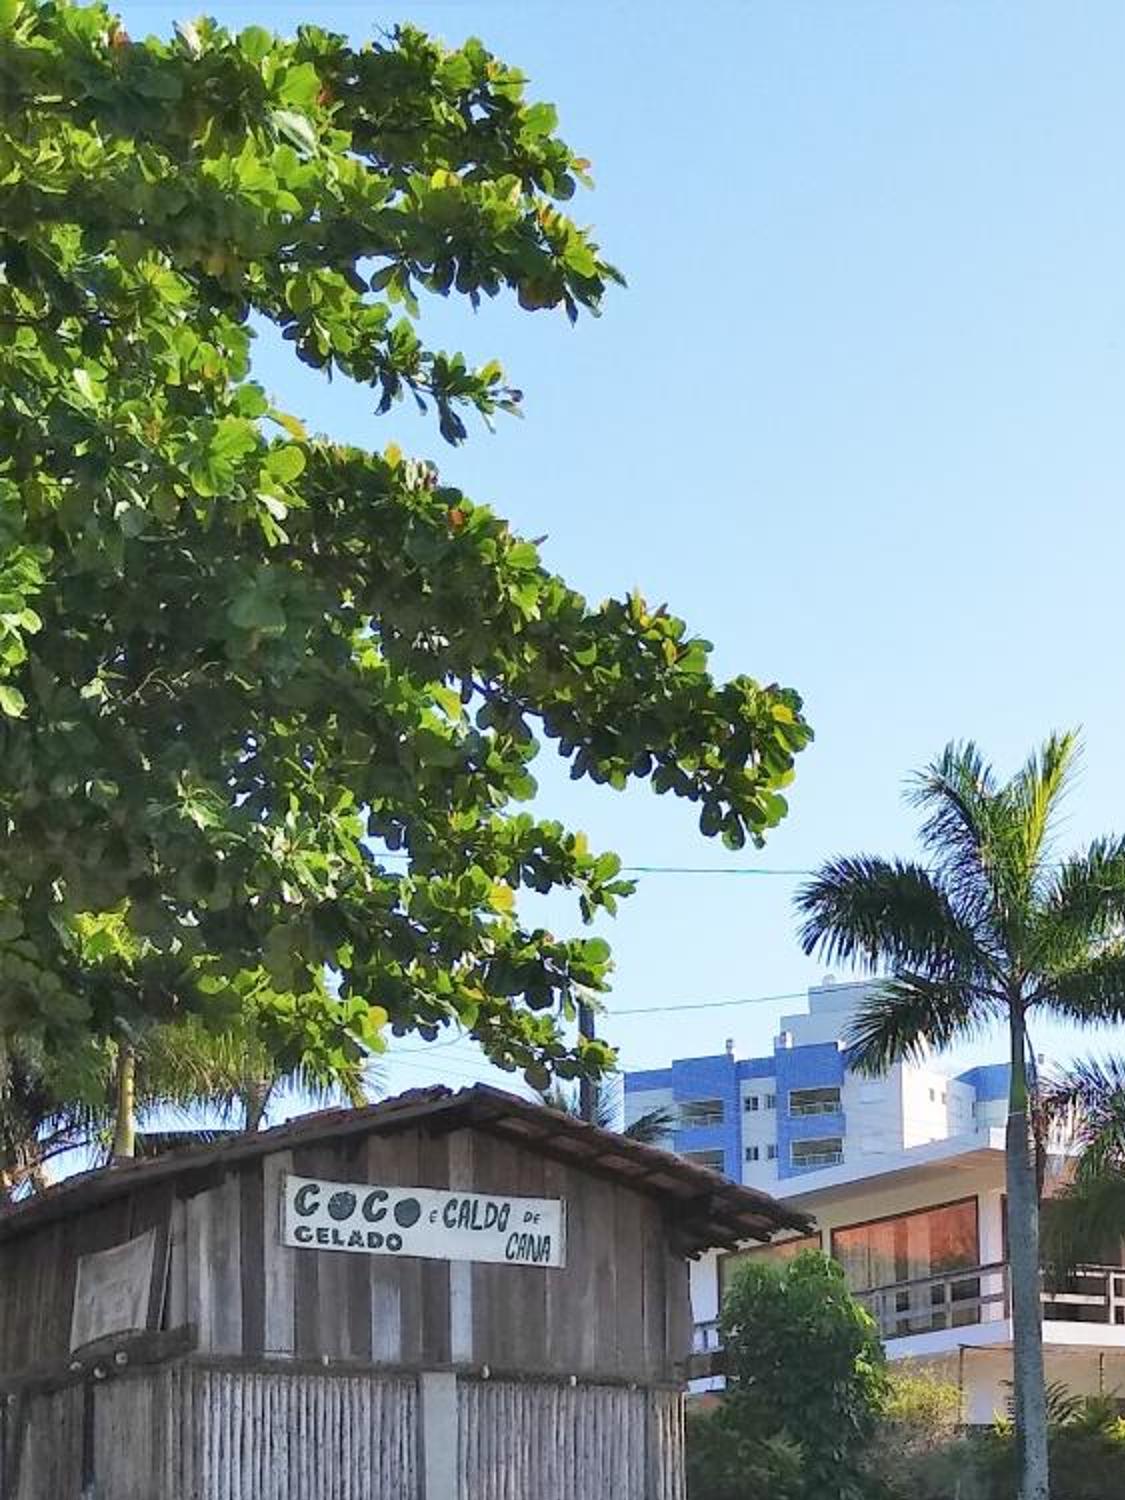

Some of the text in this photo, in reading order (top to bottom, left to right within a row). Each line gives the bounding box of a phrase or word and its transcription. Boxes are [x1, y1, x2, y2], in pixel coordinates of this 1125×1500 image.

[294, 1184, 421, 1228] COCO
[443, 1198, 511, 1232] CALDO
[523, 1210, 541, 1224] DE
[294, 1225, 403, 1251] GELADO
[505, 1231, 551, 1263] CANA
